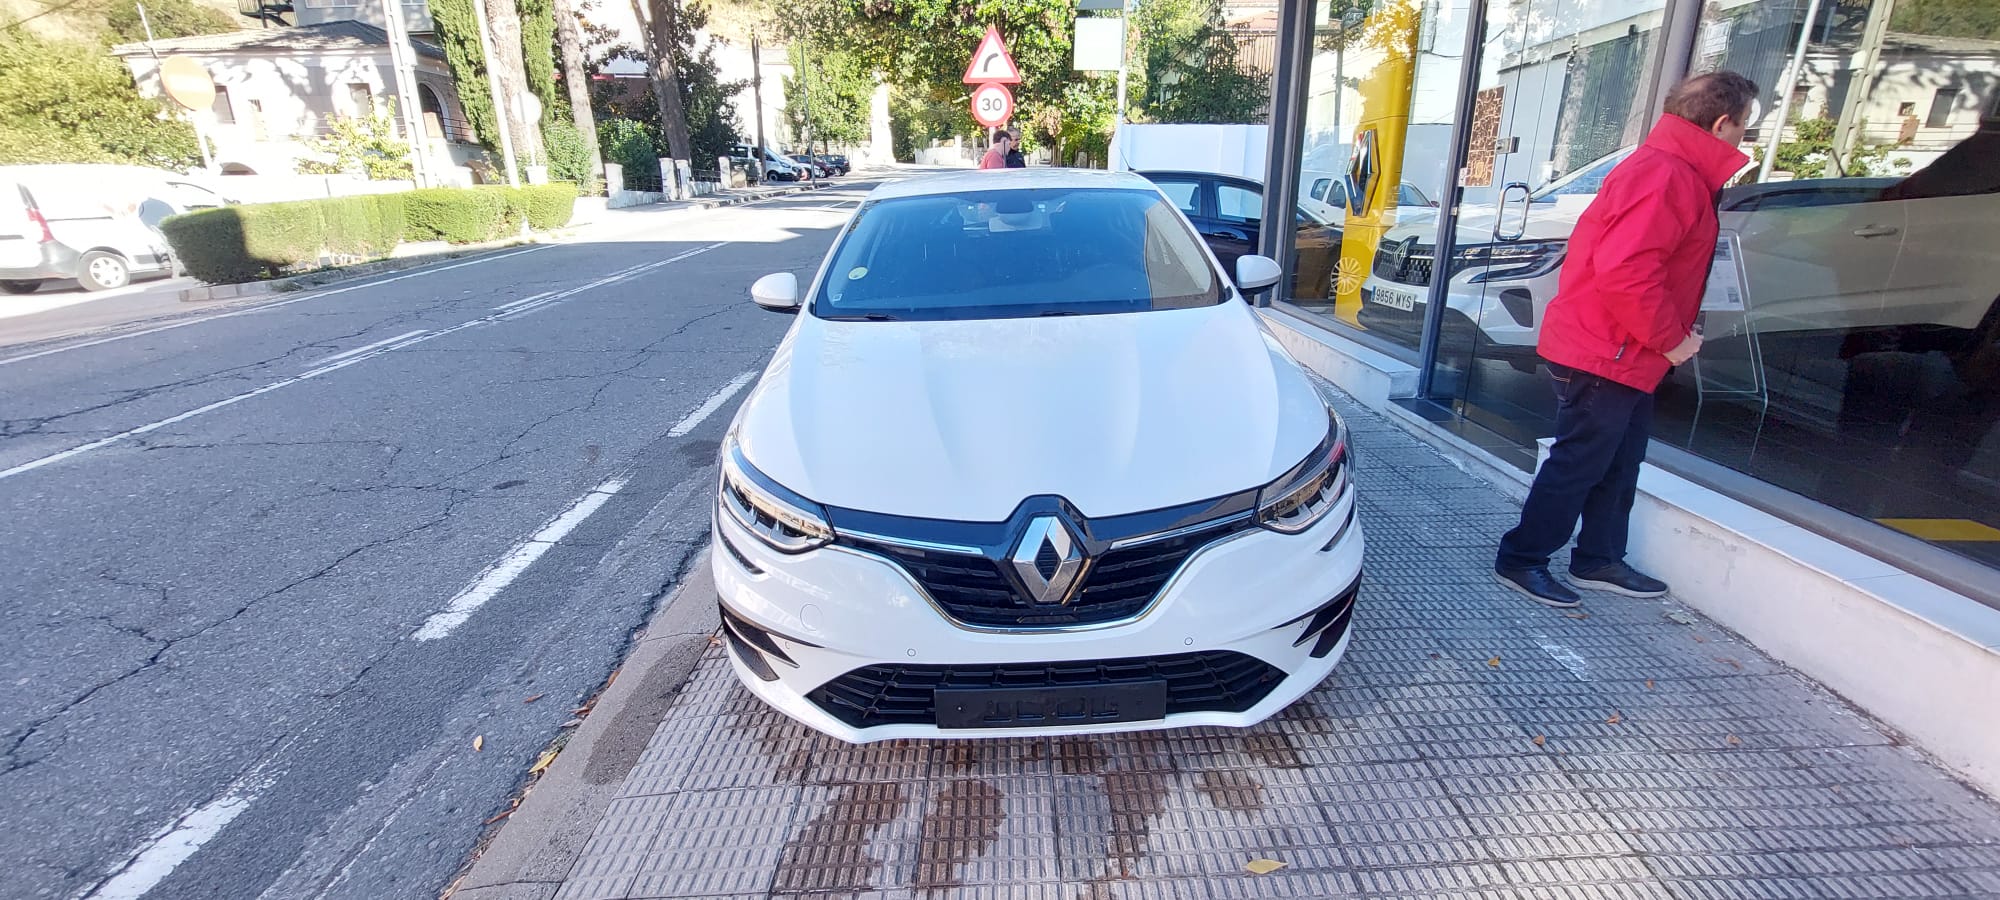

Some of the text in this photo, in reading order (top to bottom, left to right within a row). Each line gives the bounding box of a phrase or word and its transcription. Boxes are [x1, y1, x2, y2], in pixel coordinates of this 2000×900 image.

[982, 98, 1002, 111] 30
[1376, 289, 1411, 308] 9856 MYS
